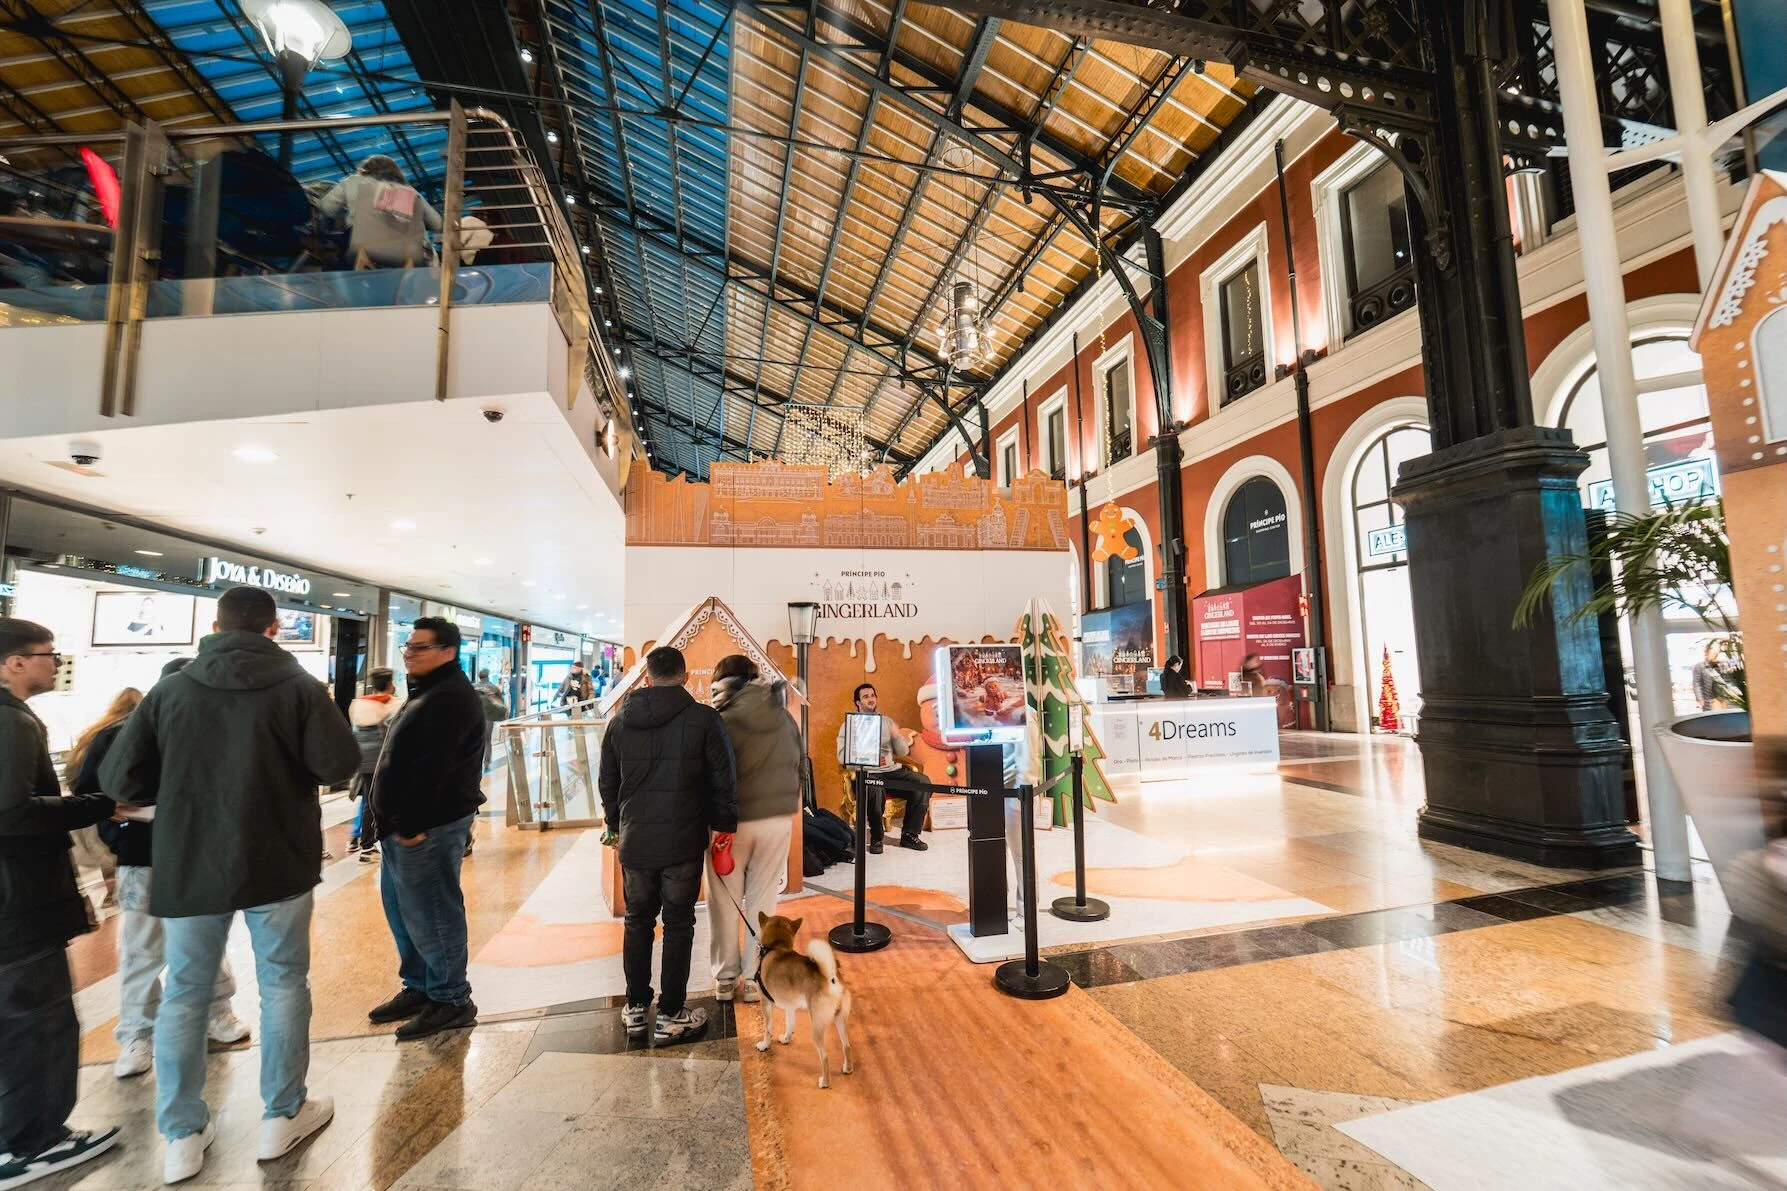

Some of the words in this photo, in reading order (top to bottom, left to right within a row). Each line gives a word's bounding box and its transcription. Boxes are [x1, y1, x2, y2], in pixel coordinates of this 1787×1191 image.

[1275, 513, 1286, 523] PÍO
[208, 557, 247, 584] JOYA
[247, 566, 262, 587] &
[263, 568, 311, 594] DISEÑO
[1149, 720, 1237, 741] 4Dreams
